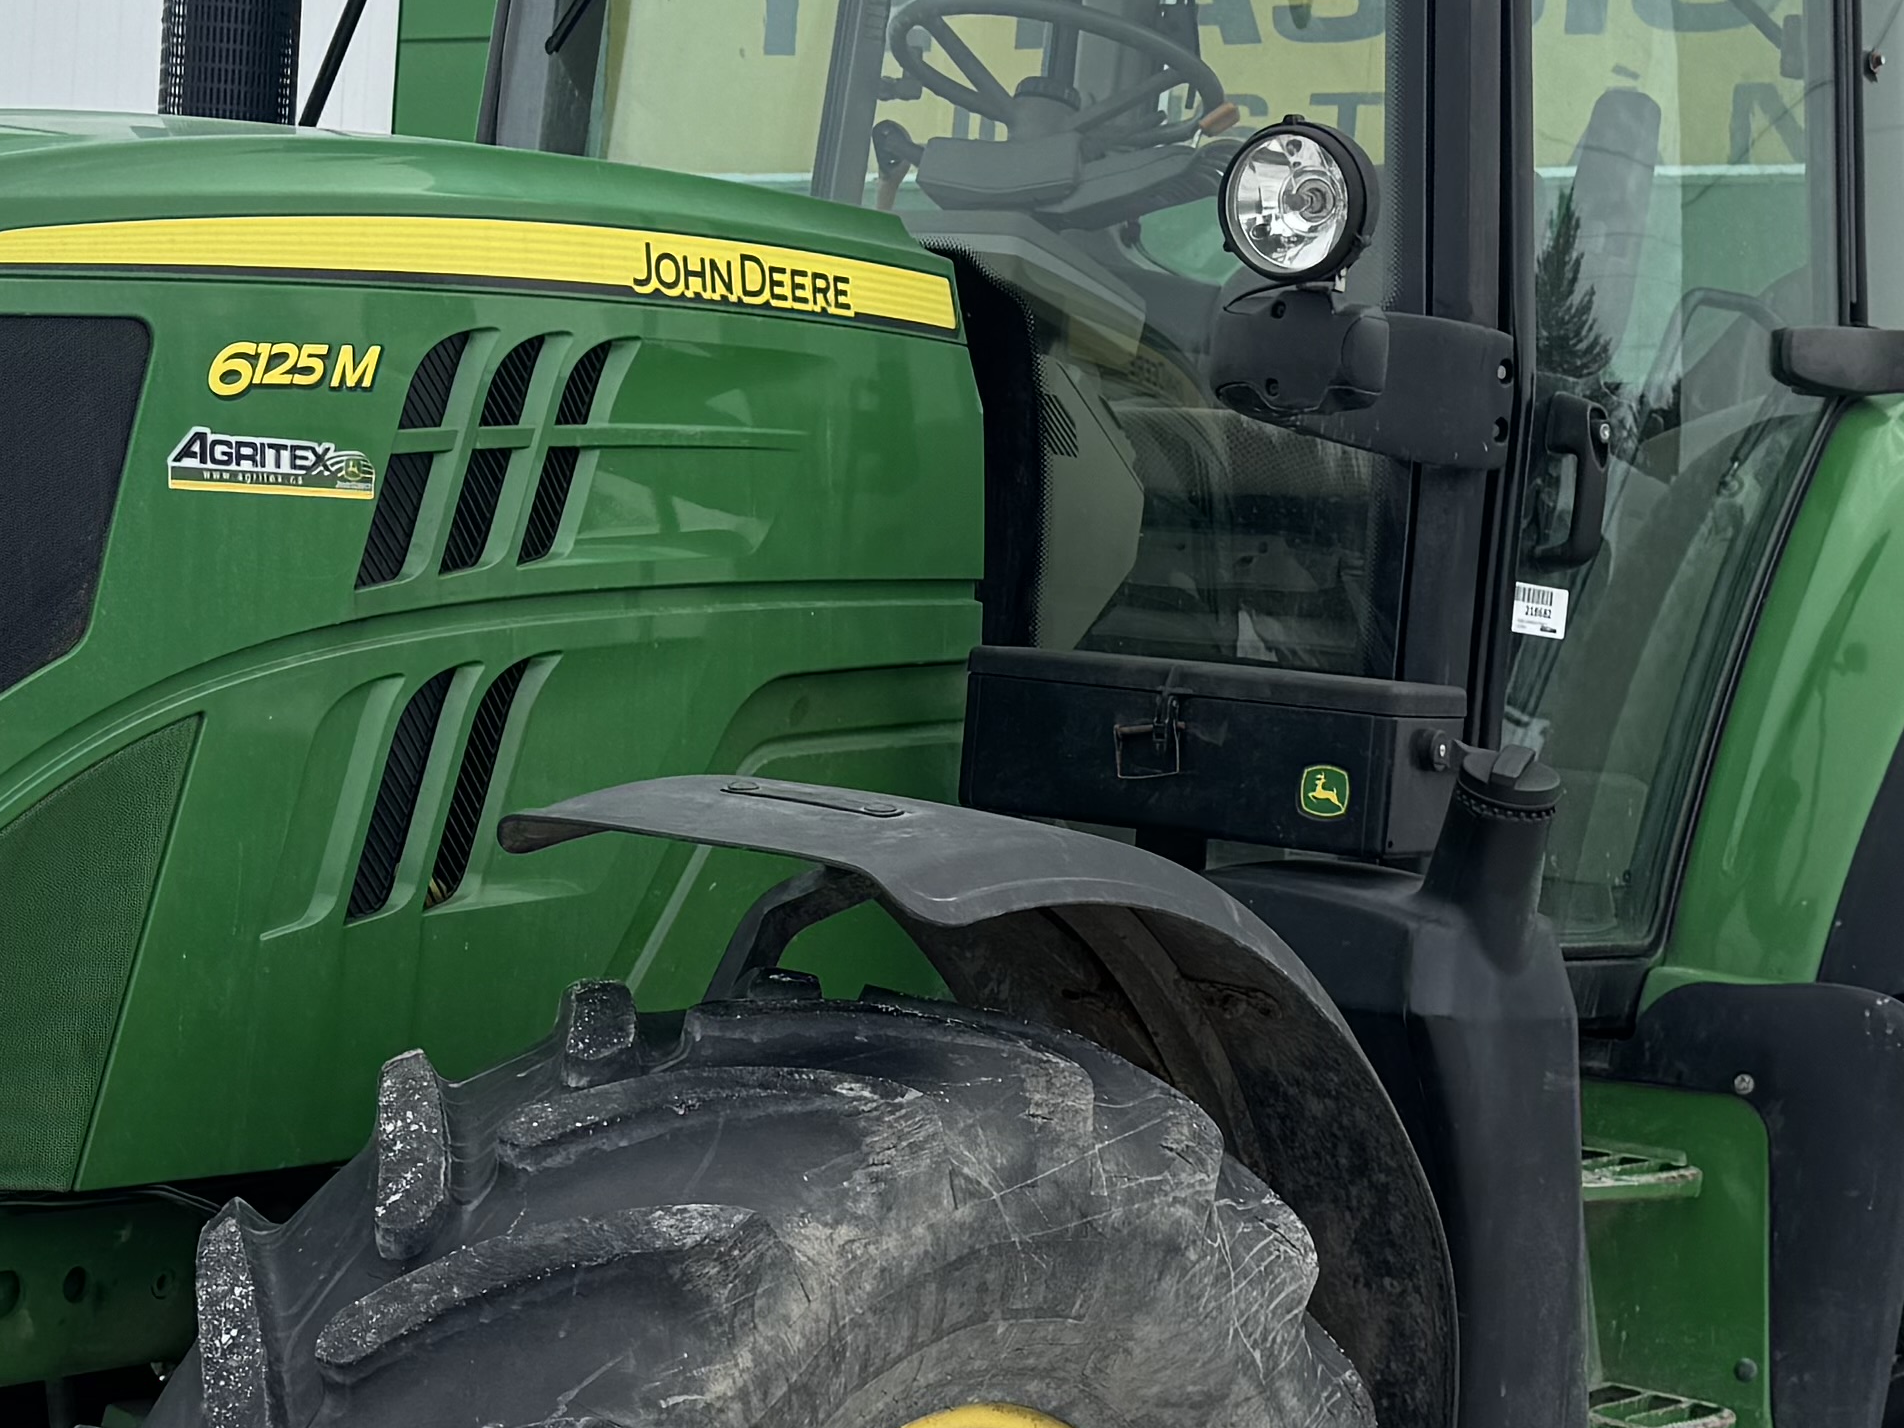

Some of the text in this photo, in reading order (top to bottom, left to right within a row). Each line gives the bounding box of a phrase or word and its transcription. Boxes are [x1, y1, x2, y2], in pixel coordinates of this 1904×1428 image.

[633, 241, 853, 311] JOHN DEERE
[172, 431, 333, 475] AGRITEX
